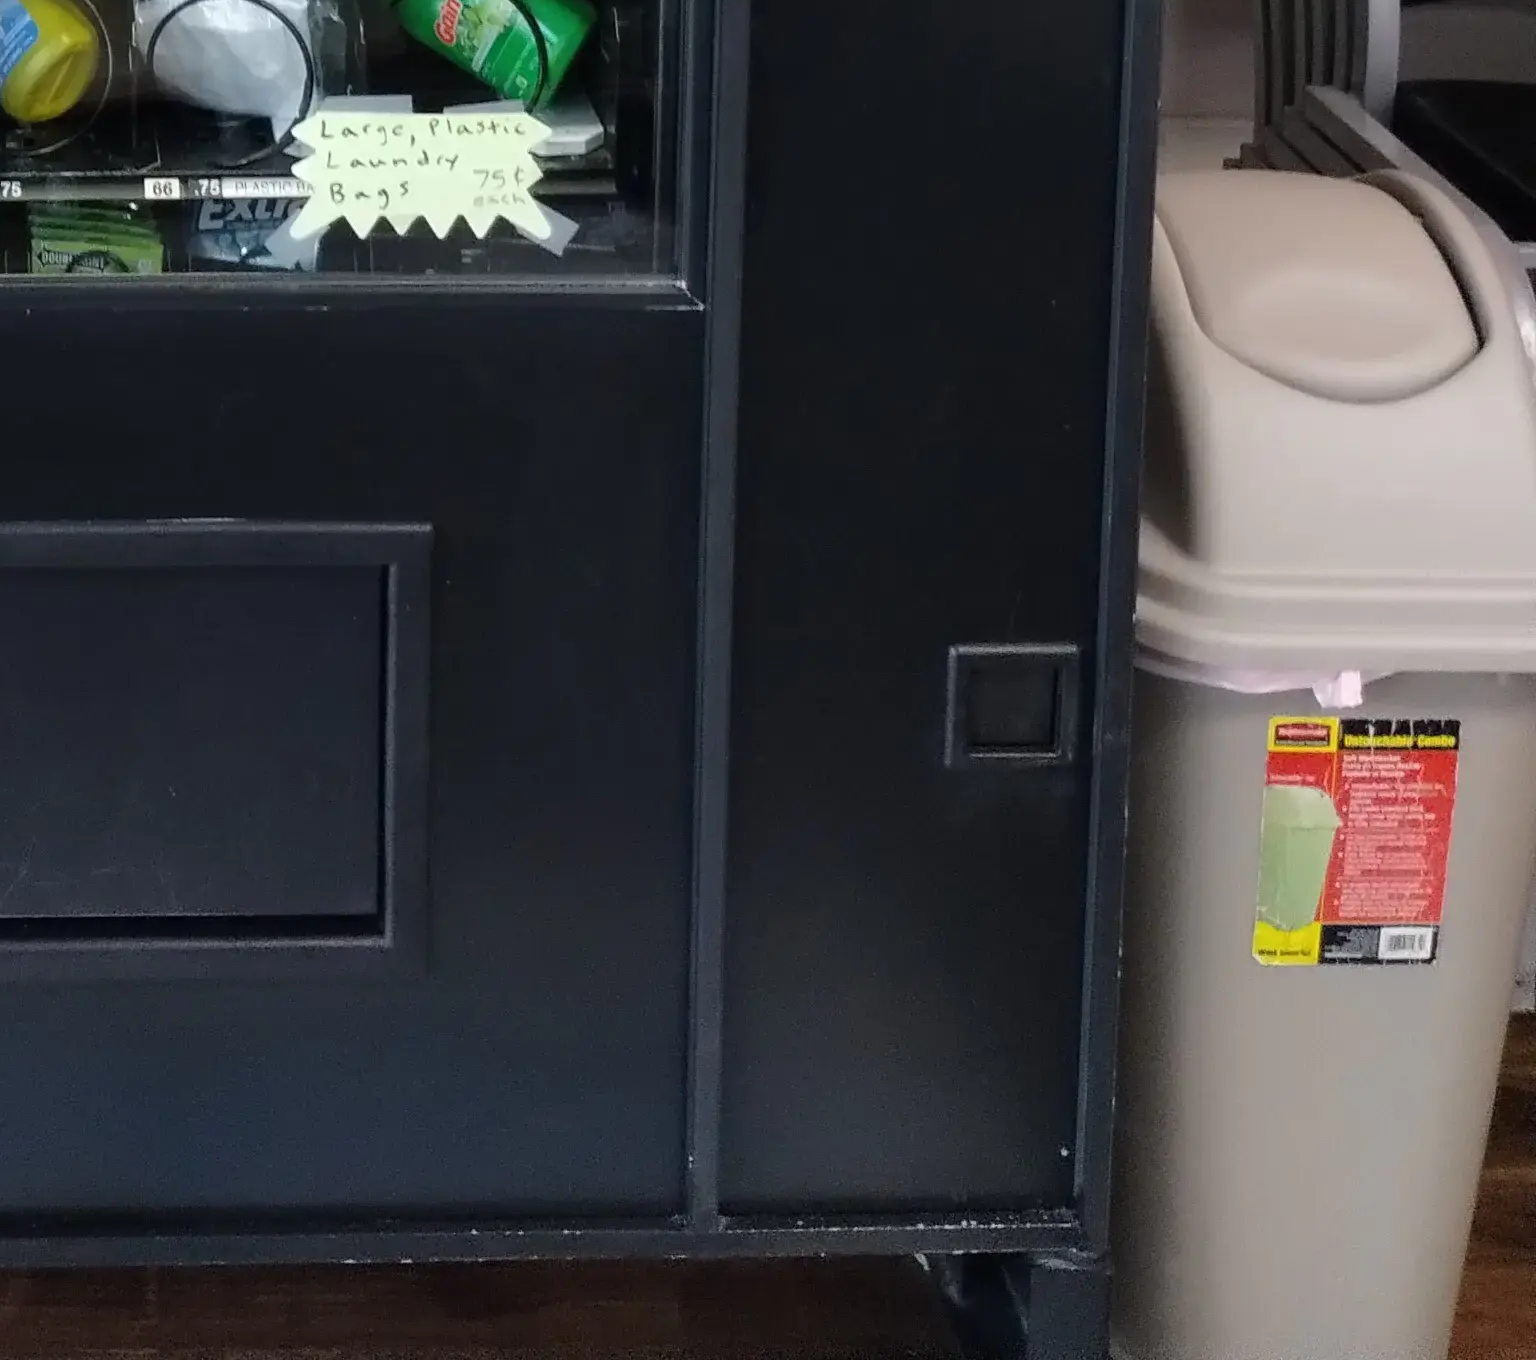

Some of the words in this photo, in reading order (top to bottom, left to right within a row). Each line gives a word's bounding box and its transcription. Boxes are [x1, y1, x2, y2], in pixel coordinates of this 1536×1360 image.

[429, 119, 527, 137] Plastic
[326, 151, 460, 170] Laundry
[152, 179, 173, 195] 66
[330, 181, 410, 209] Bags
